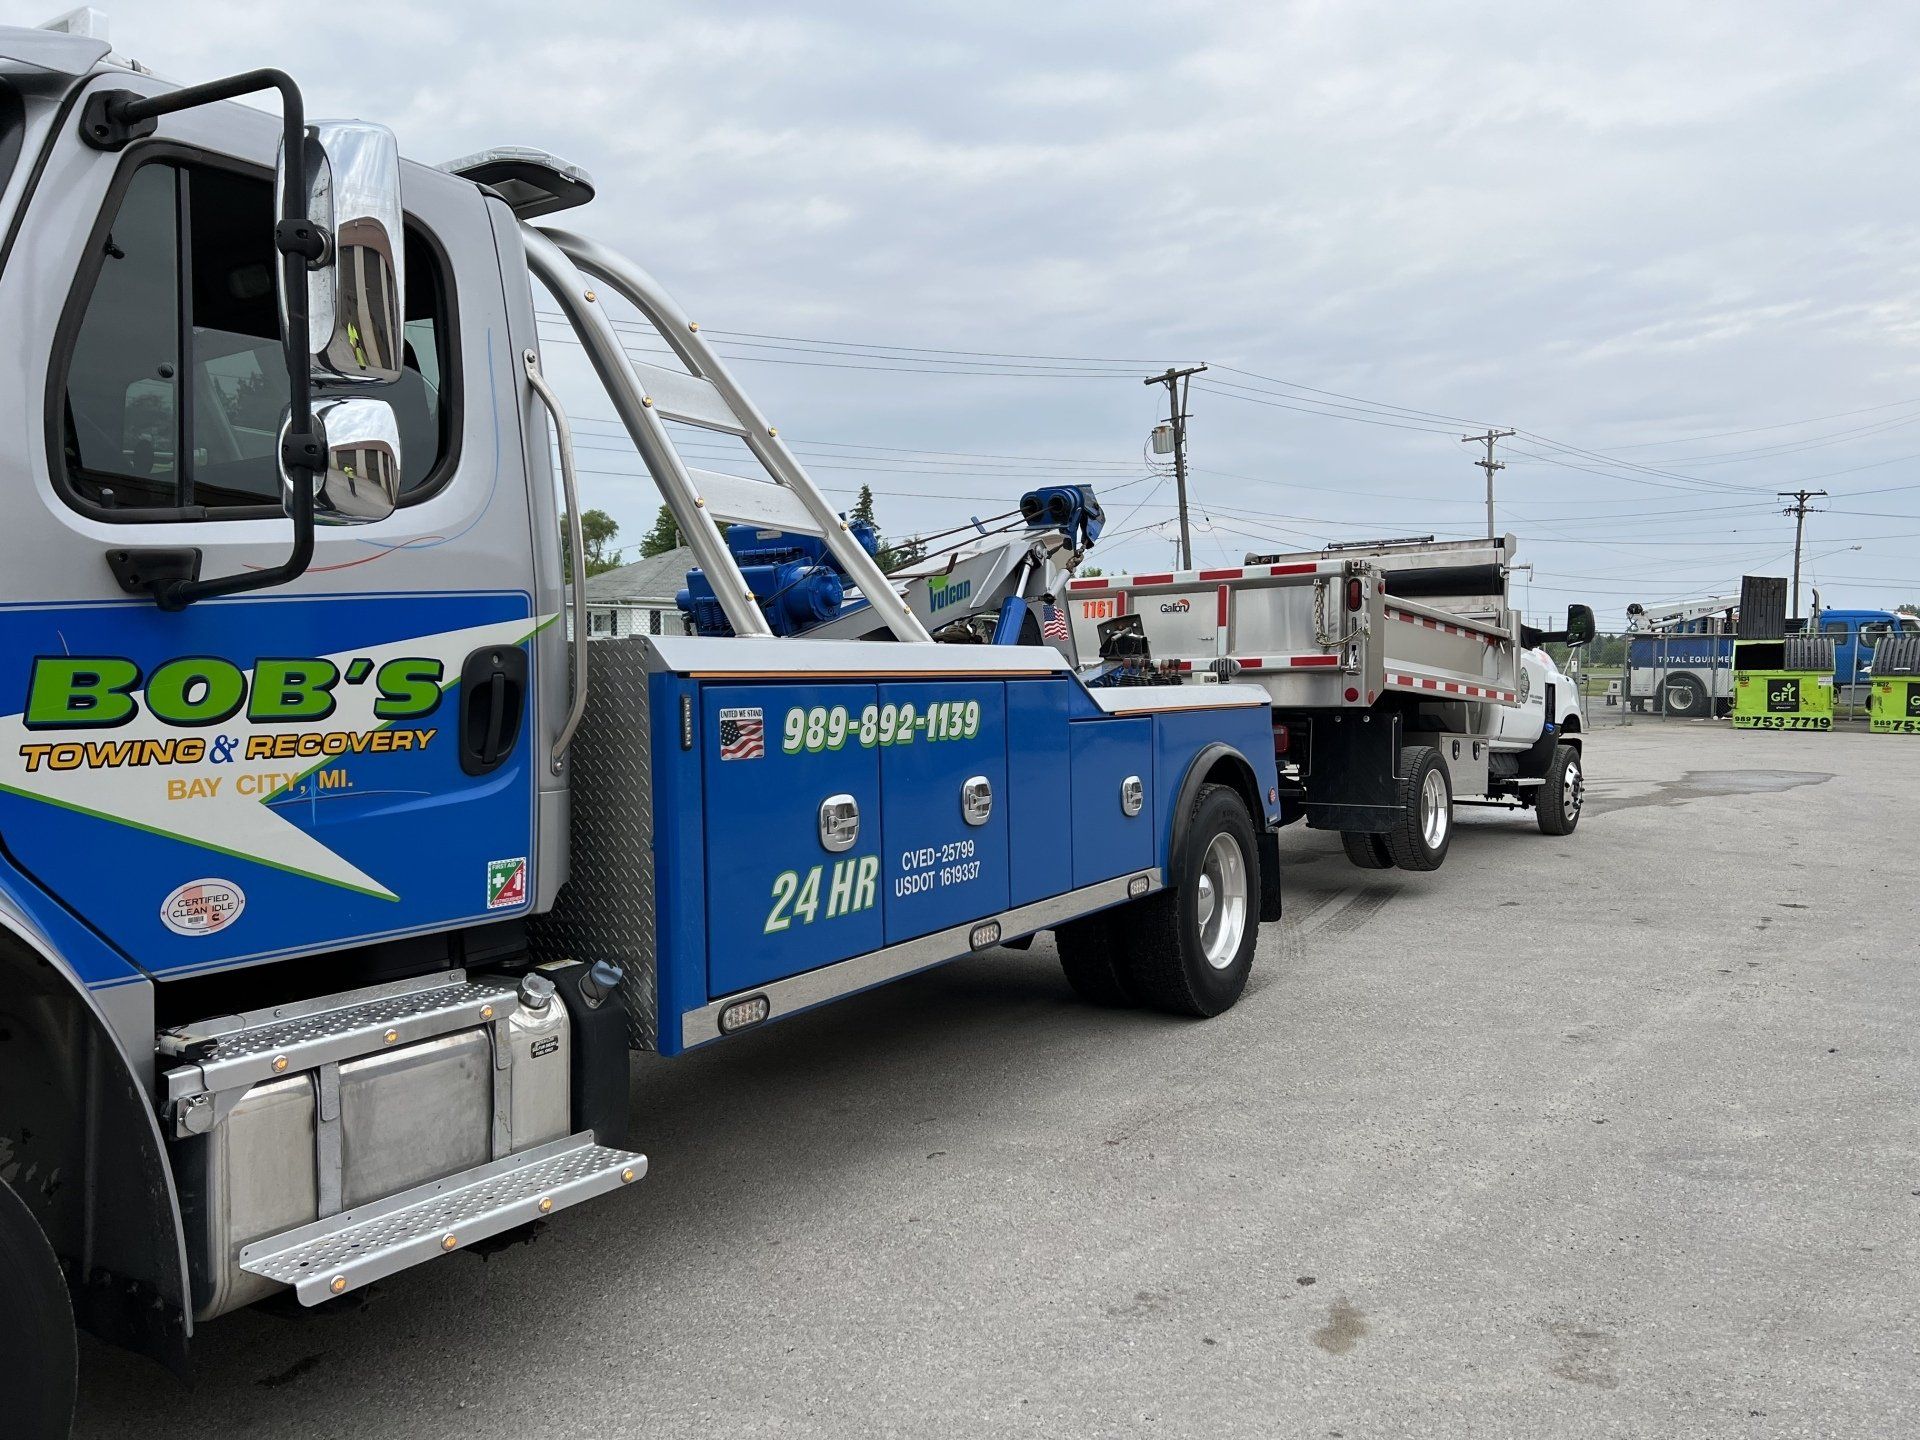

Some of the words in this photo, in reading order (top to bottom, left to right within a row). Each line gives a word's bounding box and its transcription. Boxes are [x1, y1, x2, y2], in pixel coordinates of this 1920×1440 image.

[928, 579, 971, 613] Vulcan
[1082, 600, 1113, 619] 1161
[23, 655, 444, 732] BOB'S
[1770, 688, 1796, 702] GFL
[721, 710, 738, 718] UNITED
[747, 709, 762, 717] STAND
[782, 700, 980, 754] 989-892-1139
[1752, 716, 1831, 728] 753-7719
[20, 738, 206, 772] TOWING
[209, 734, 239, 765] &
[245, 729, 437, 760] RECOVERY
[168, 777, 222, 800] BAY
[236, 772, 306, 795] CITY,
[319, 770, 353, 789] MI.
[902, 840, 975, 871] CVED-25799
[895, 871, 936, 897] USDOT
[939, 861, 981, 887] 1619337
[178, 894, 229, 908] CERTIFIED
[764, 865, 823, 934] 24
[826, 855, 879, 919] HR
[172, 906, 207, 918] CLEAN
[212, 902, 234, 912] IDLE
